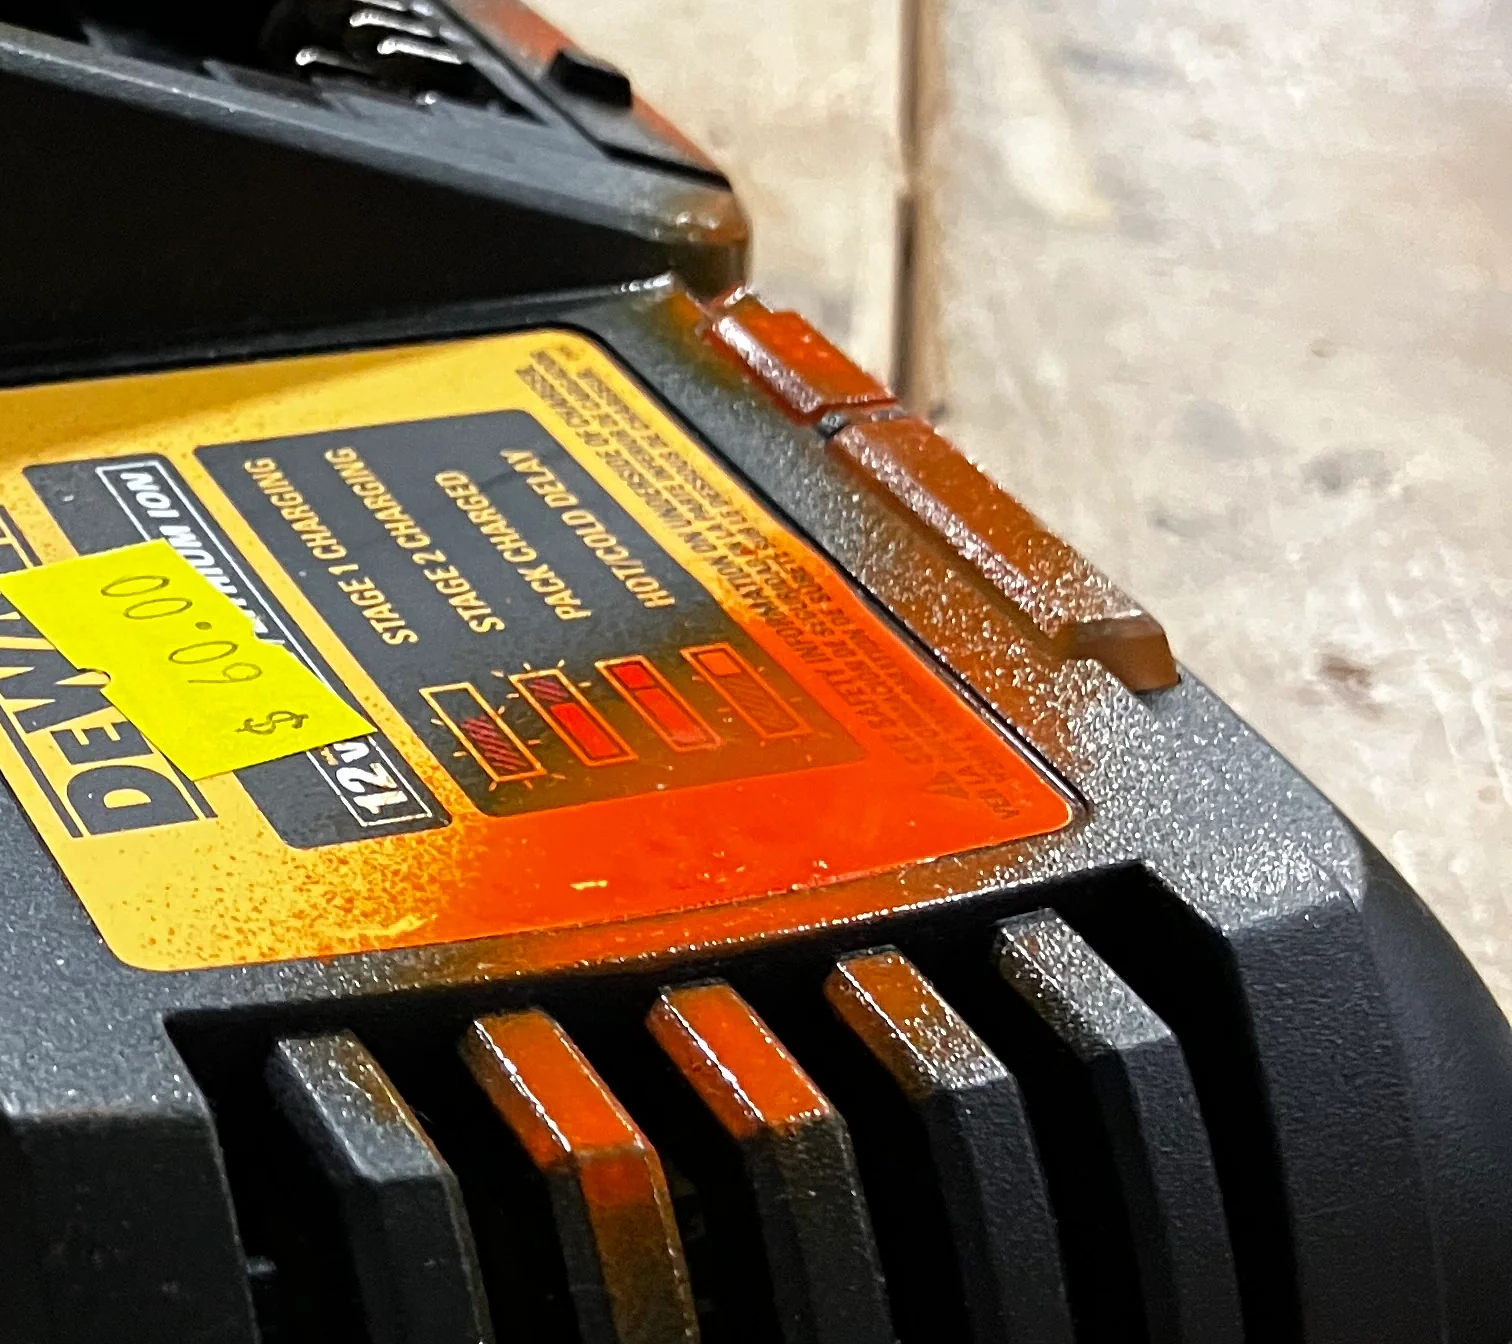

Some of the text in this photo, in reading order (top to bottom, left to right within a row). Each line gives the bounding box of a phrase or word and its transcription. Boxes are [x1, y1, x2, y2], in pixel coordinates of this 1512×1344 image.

[119, 474, 181, 516] ION
[245, 459, 420, 645] STAGE 1 CHARGING
[325, 448, 505, 634] STAGE 2 CHARGING
[434, 471, 591, 620] PACK CHARGED
[498, 451, 674, 608] HOT/COLD DELAY
[99, 574, 311, 733] $ 60.00
